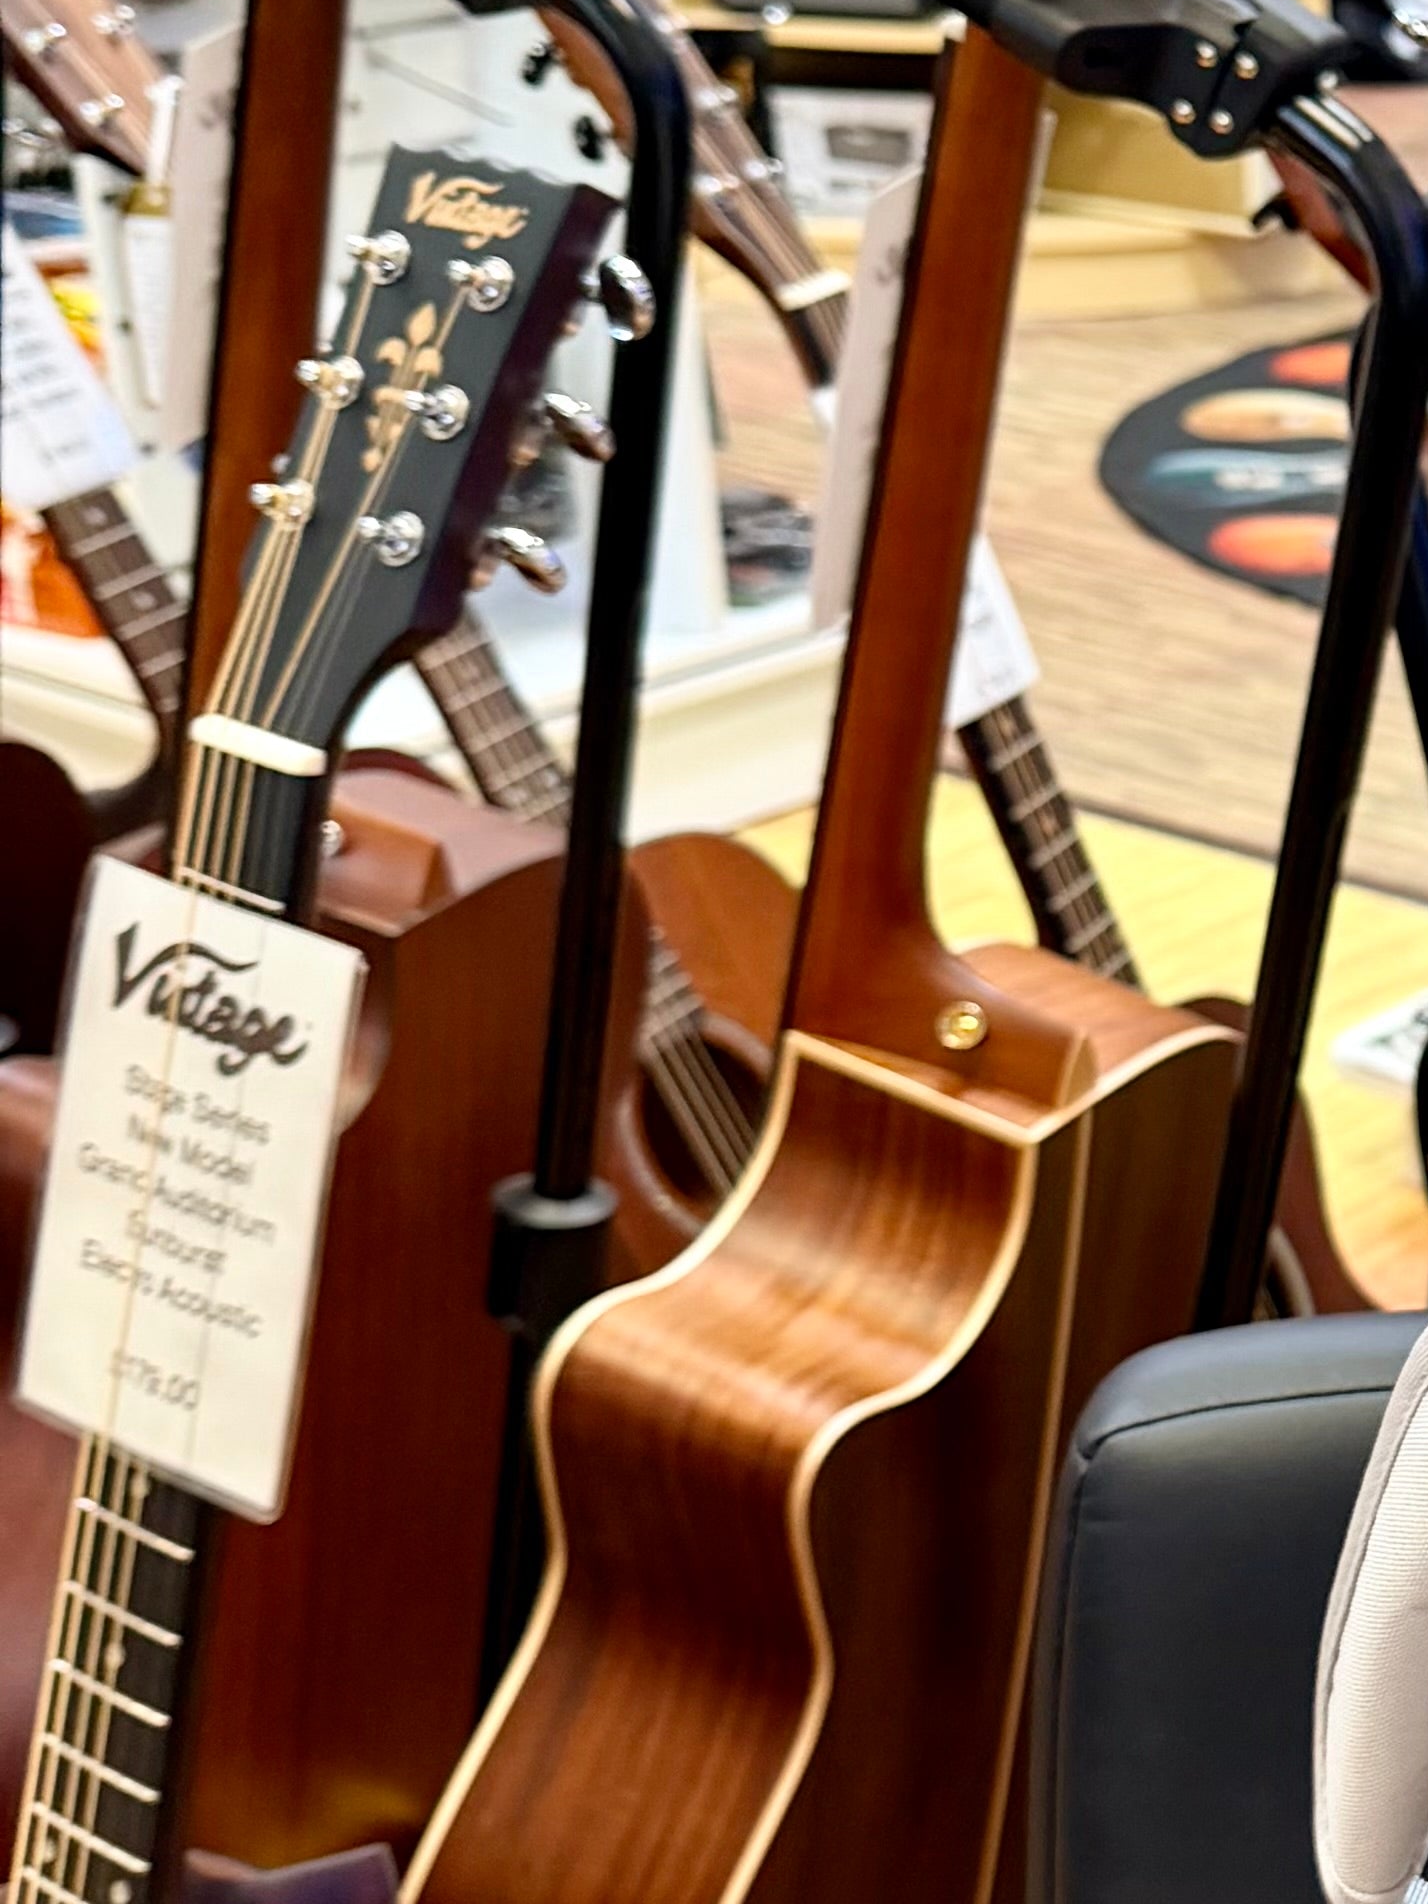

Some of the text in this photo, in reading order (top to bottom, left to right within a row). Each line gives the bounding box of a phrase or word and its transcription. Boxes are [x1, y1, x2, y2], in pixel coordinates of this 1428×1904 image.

[404, 170, 530, 250] Vintage
[111, 921, 308, 1076] Vintage
[191, 1091, 271, 1145] Series
[179, 1135, 255, 1186] Model
[153, 1174, 277, 1247] Auditorium
[156, 1276, 264, 1339] Acoustic
